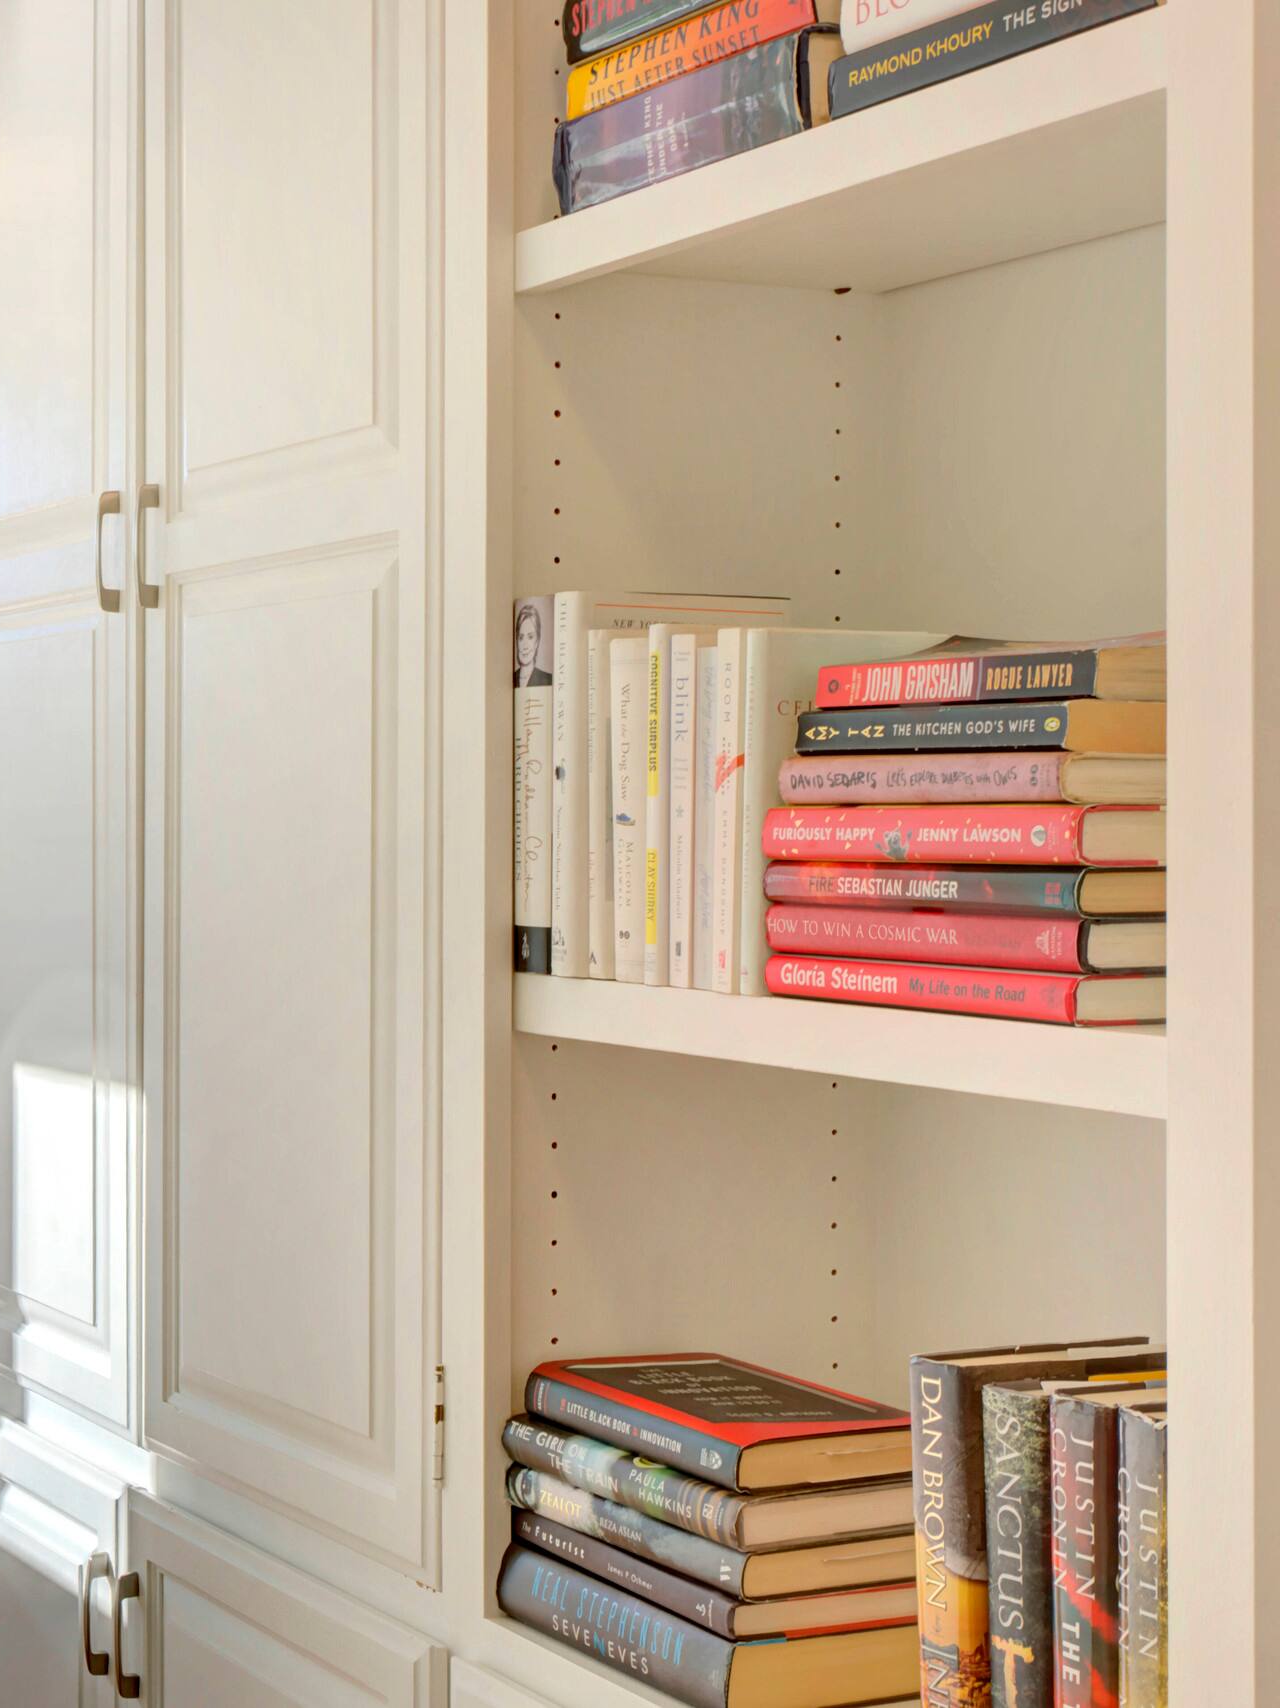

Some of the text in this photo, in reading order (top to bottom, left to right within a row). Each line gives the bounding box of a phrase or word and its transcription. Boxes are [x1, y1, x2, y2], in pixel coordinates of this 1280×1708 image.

[589, 0, 760, 86] STEPHEN KING
[848, 46, 923, 88] RAYMOND
[926, 21, 994, 61] KHOURY
[1003, 13, 1036, 33] THE
[590, 24, 761, 108] JUST AFTER SUNSET
[644, 96, 652, 128] KING
[557, 600, 568, 741] THE BLACK SWAN
[862, 666, 903, 702] JOHN
[905, 661, 975, 700] GRISHAM
[986, 663, 1073, 691] ROGUE LAWYER
[620, 683, 632, 721] What
[674, 677, 690, 743] blink
[723, 663, 733, 723] ROOM
[648, 655, 658, 772] COGNITIVE SURPLUS
[805, 725, 885, 740] AMY TAN
[893, 718, 1036, 737] THE KITCHEN GOD'S WIFE
[618, 741, 631, 771] Dog
[619, 775, 630, 801] Saw
[790, 773, 824, 789] DAVID
[827, 771, 878, 789] SEDARIS
[773, 827, 875, 842] FURIOUSLY HAPPY
[916, 827, 1022, 842] JENNY LAWSON
[646, 852, 657, 922] CLAY SHIRKY
[809, 876, 958, 899] FIRE SEBASTIAN JUNGER
[767, 918, 798, 934] HOW
[802, 919, 819, 935] TO
[824, 922, 851, 938] WIN
[856, 924, 864, 938] A
[868, 924, 921, 943] COSMIC
[925, 927, 959, 945] WAR
[780, 962, 898, 993] Gloria Steinem
[909, 976, 1026, 1002] My Life on the Road
[509, 1420, 587, 1460] THE GIRL ON
[566, 1402, 588, 1419] LITTLE
[589, 1410, 612, 1430] BLACK
[612, 1418, 631, 1435] BOOK
[639, 1428, 683, 1453] INNOVATION
[547, 1451, 619, 1493] THE TRAIN
[629, 1469, 665, 1493] PAULA
[539, 1489, 583, 1518] ZEALOT
[638, 1487, 692, 1519] HAWKINS
[921, 1375, 947, 1612] DAN BROWN
[1051, 1427, 1068, 1592] CRONIN
[599, 1516, 642, 1543] REZA ASLAN
[994, 1411, 1025, 1632] SANCTUS
[1070, 1432, 1096, 1601] JUSTIN
[1135, 1475, 1159, 1662] JUSTIN
[531, 1567, 686, 1665] NEAL STEPHENSON
[552, 1614, 649, 1675] SEVENEVES
[1061, 1621, 1081, 1685] THE
